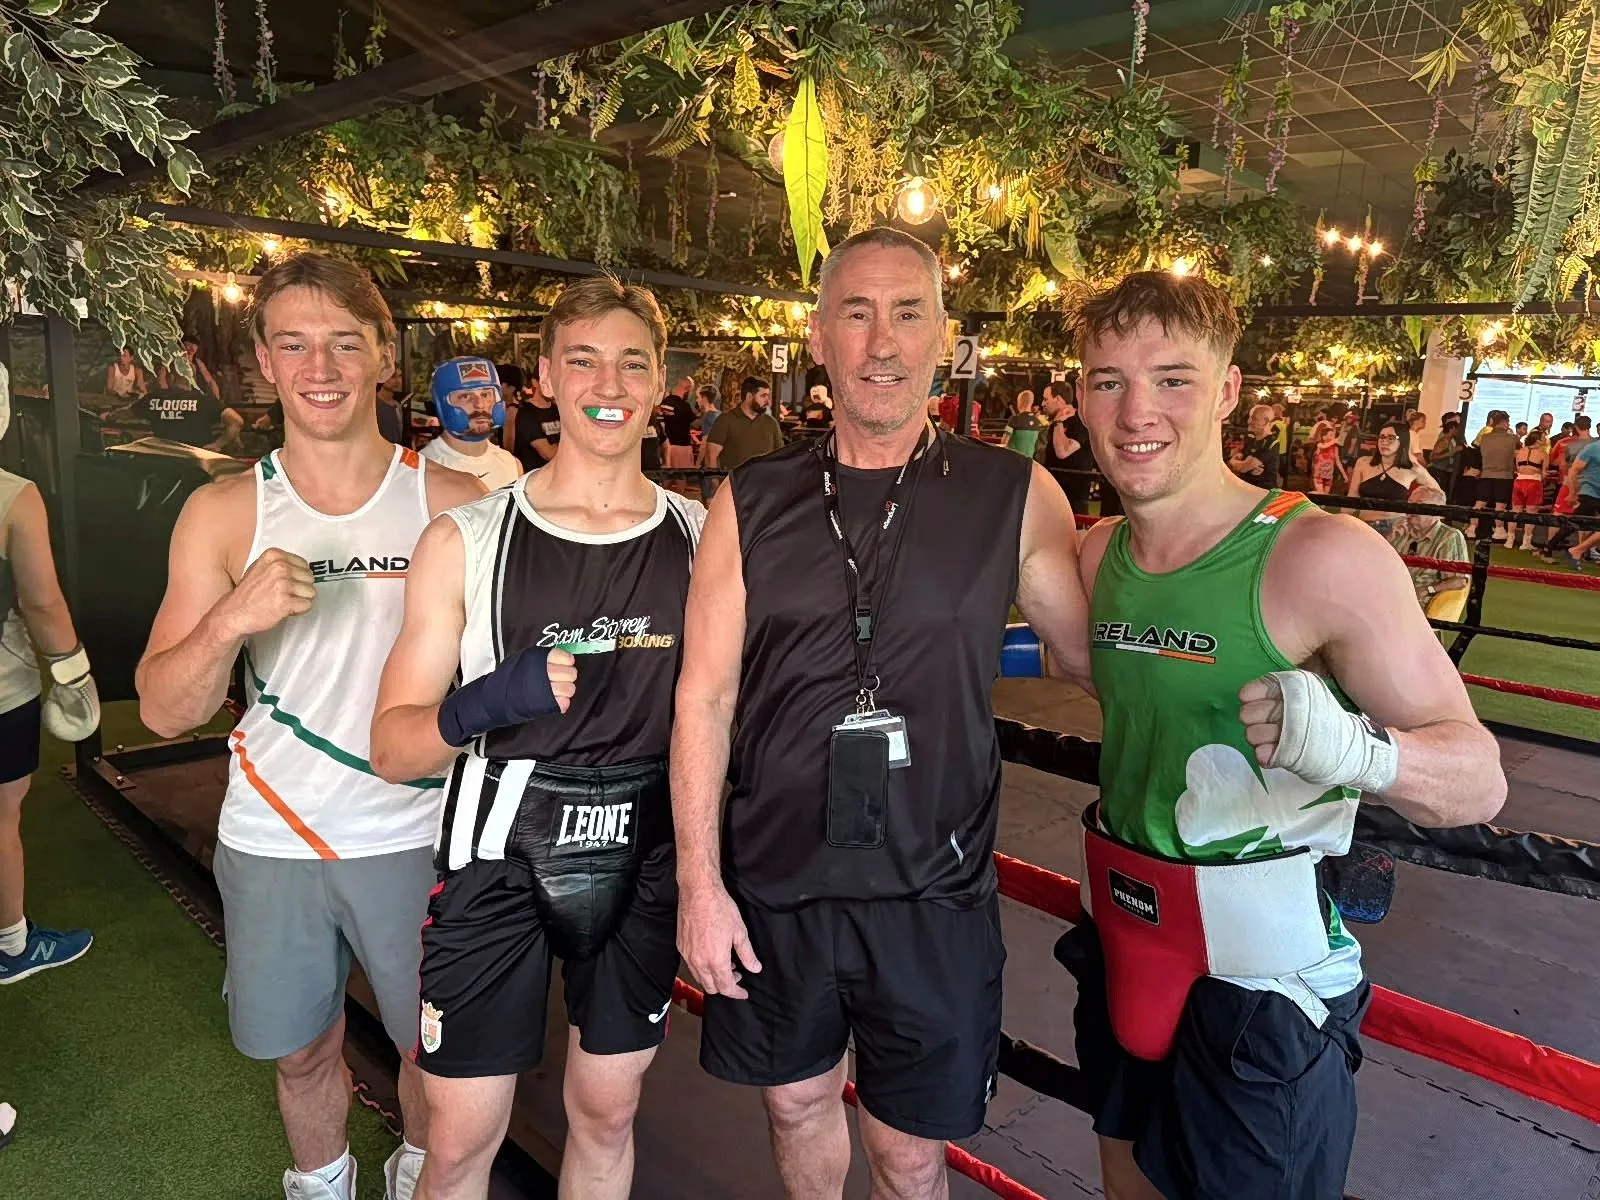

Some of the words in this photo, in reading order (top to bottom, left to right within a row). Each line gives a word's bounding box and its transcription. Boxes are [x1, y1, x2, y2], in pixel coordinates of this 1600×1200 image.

[774, 347, 785, 370] 5
[955, 339, 974, 375] 2
[1459, 380, 1474, 401] 3
[149, 398, 198, 412] SLOUGH
[308, 556, 410, 576] ELAND
[536, 622, 586, 648] Sam
[556, 802, 633, 847] LEONE
[580, 840, 609, 849] 1947
[1113, 887, 1155, 915] PHENOM
